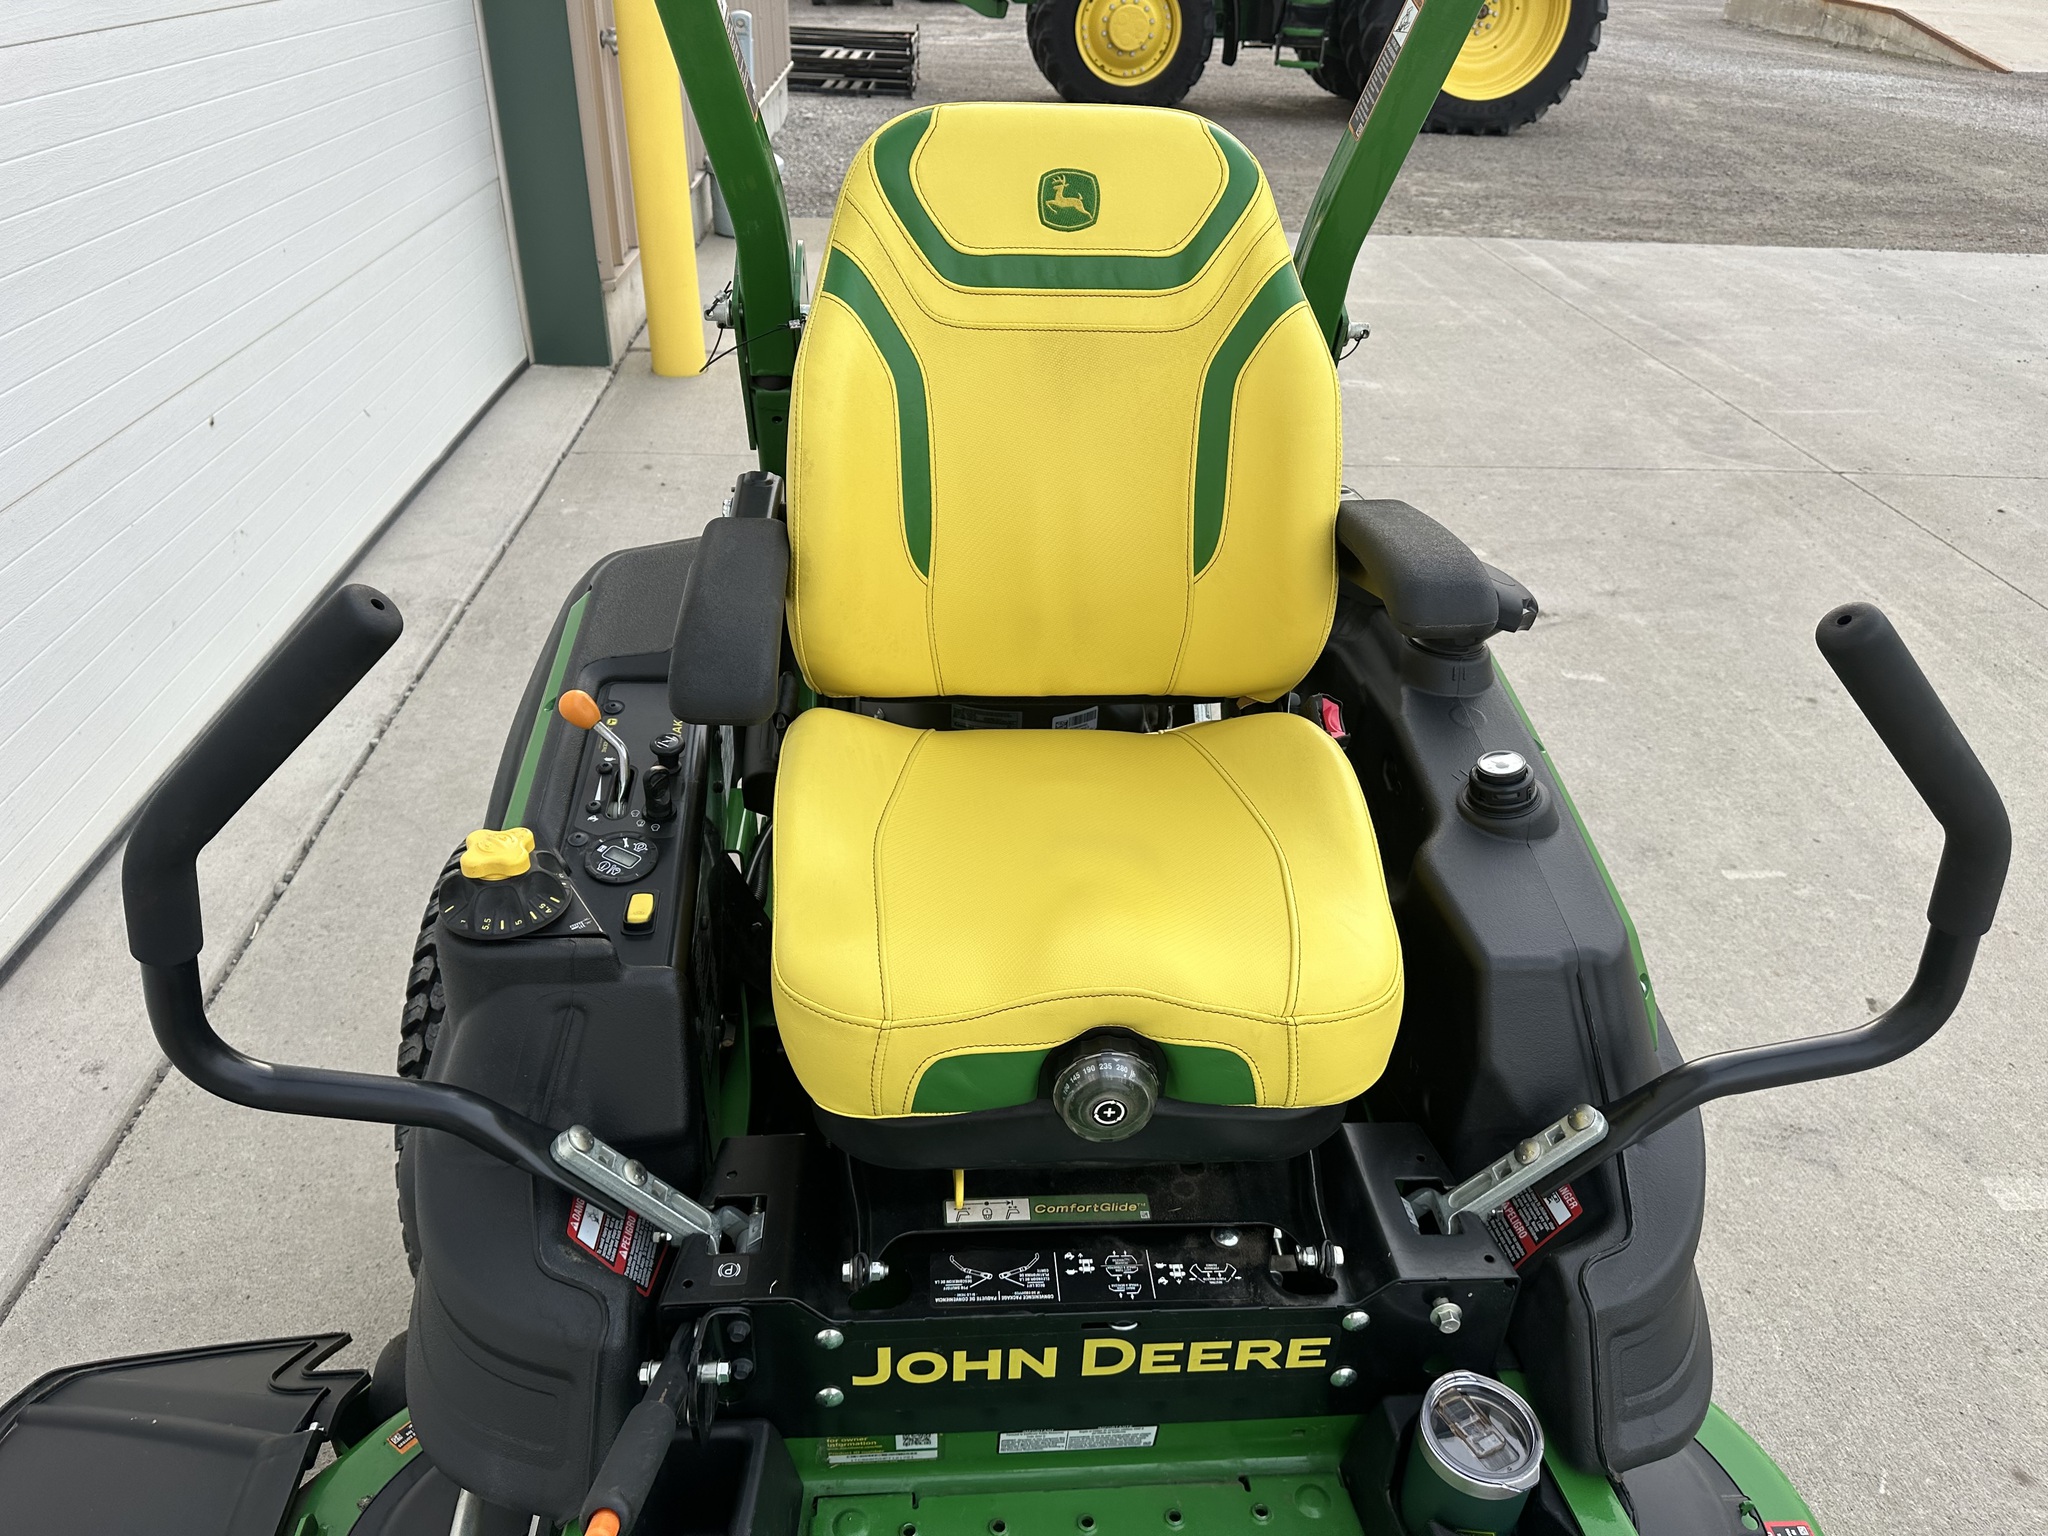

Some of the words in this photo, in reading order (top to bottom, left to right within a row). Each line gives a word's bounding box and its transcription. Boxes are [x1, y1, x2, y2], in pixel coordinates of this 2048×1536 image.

[672, 719, 683, 736] AK
[482, 917, 492, 930] 5.5
[1070, 1071, 1081, 1084] 145
[1082, 1064, 1096, 1075] 190
[1098, 1062, 1113, 1070] 235
[1116, 1063, 1129, 1073] 280
[1558, 1185, 1578, 1209] NGER
[572, 1198, 585, 1221] DANG
[621, 1216, 635, 1250] PELIGRO
[1505, 1208, 1527, 1239] PELIGRO
[851, 1346, 1059, 1387] JOHN
[1081, 1336, 1332, 1378] DEERE
